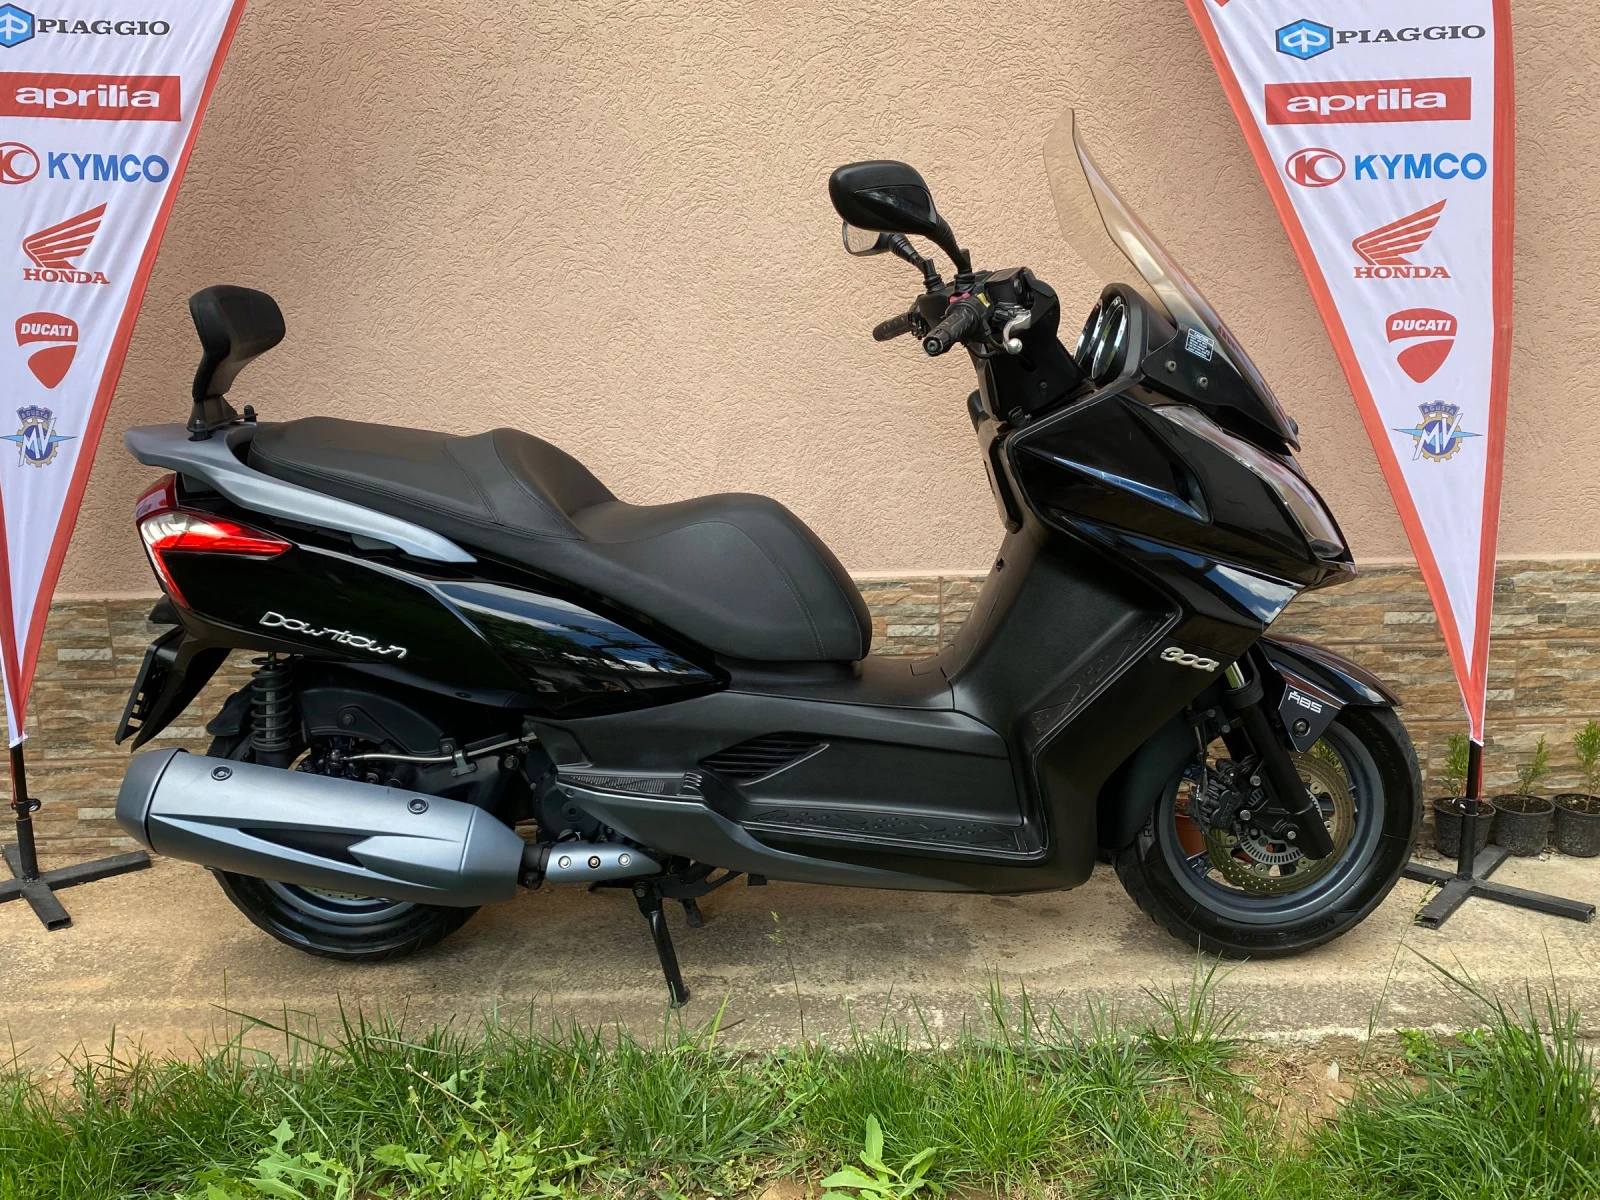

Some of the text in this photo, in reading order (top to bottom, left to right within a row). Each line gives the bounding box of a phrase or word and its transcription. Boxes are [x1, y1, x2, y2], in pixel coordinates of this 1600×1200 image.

[37, 19, 170, 36] PIAGGIO
[1336, 25, 1486, 44] PIAGGIO
[15, 84, 160, 108] aprilia
[1286, 87, 1447, 116] aprilia
[48, 151, 169, 182] KYMCO
[1354, 152, 1487, 180] KYMCO
[23, 268, 110, 284] HONDA
[1353, 266, 1452, 279] HONDA
[20, 322, 73, 337] DUCATI
[1391, 319, 1452, 331] DUCATI
[1423, 405, 1456, 415] AGUSTA
[259, 611, 408, 659] Downtown
[1288, 690, 1323, 714] ABS
